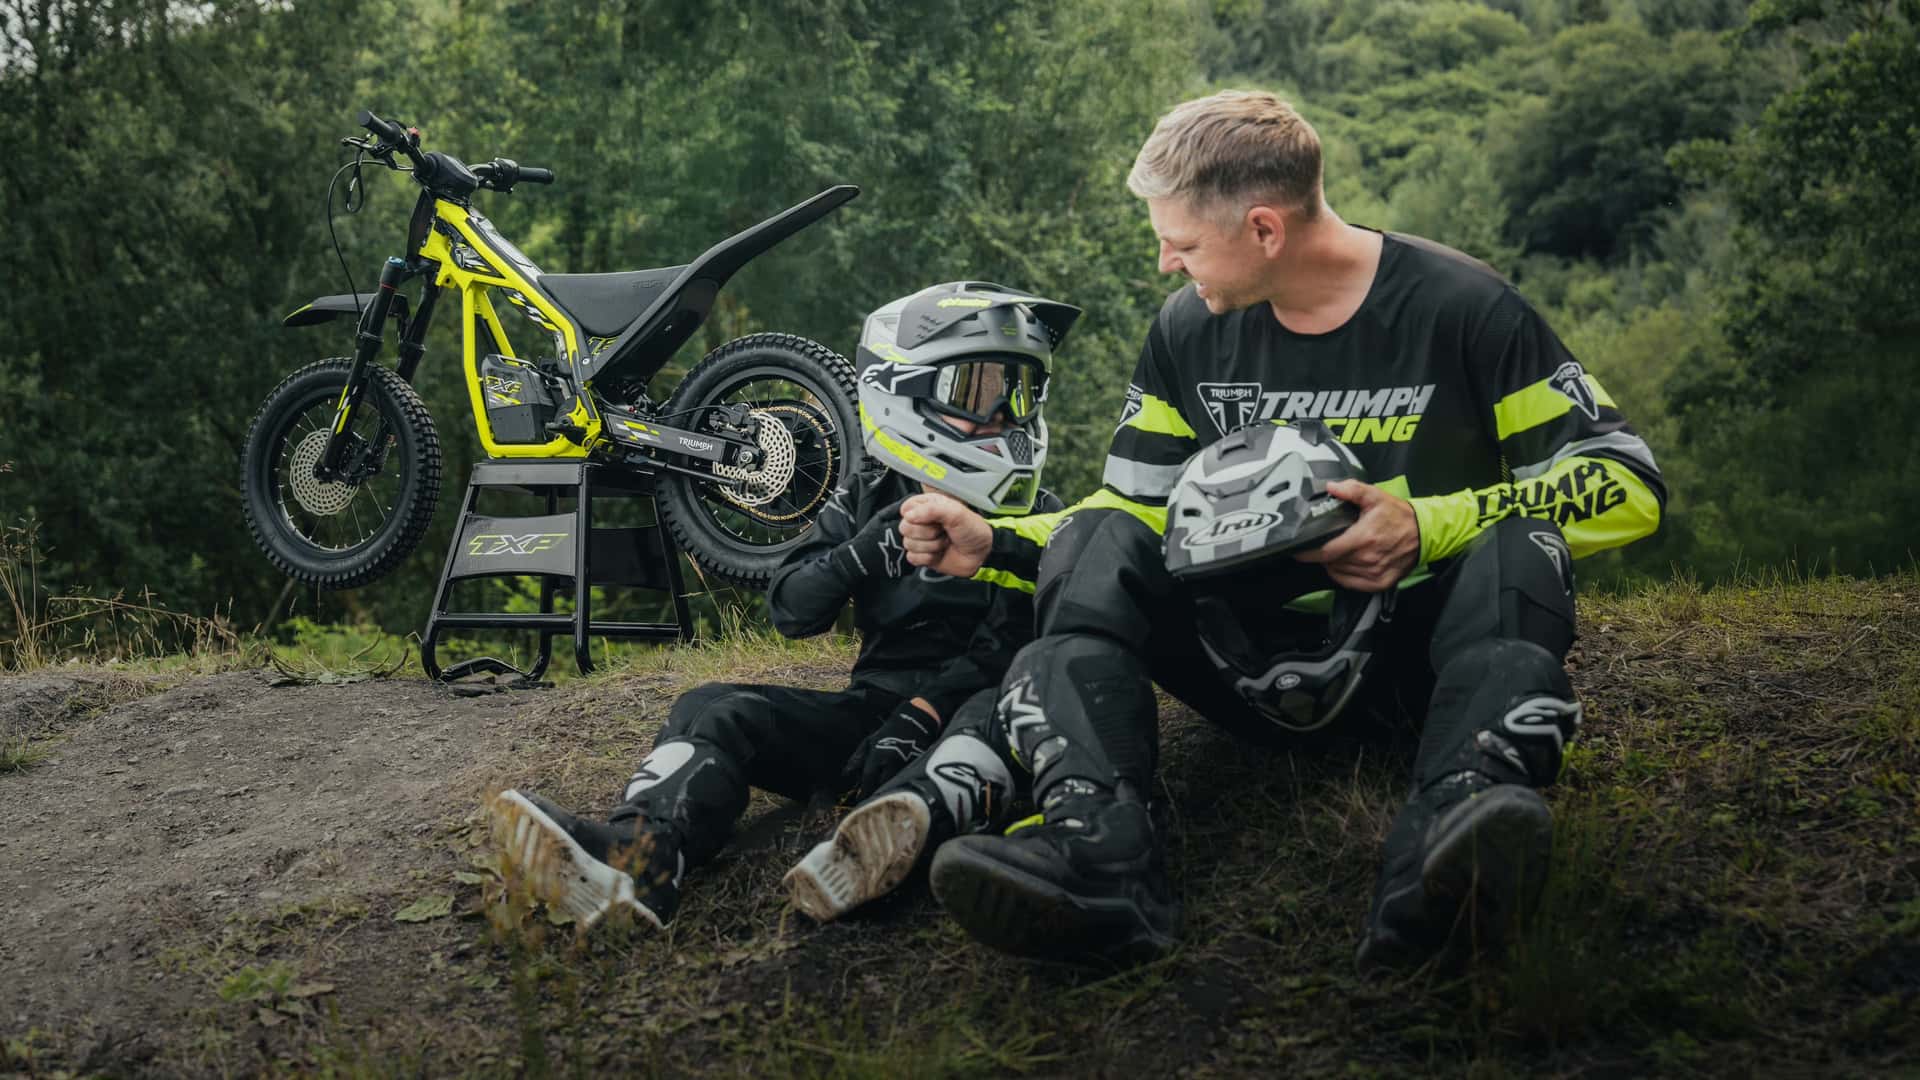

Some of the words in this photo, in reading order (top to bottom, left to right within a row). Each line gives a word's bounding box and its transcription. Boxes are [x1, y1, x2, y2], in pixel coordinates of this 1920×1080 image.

[1210, 388, 1253, 401] TRIUMPH
[1259, 384, 1436, 419] TRIUMPH
[679, 436, 713, 451] TRIUMPH
[469, 533, 569, 555] TXP
